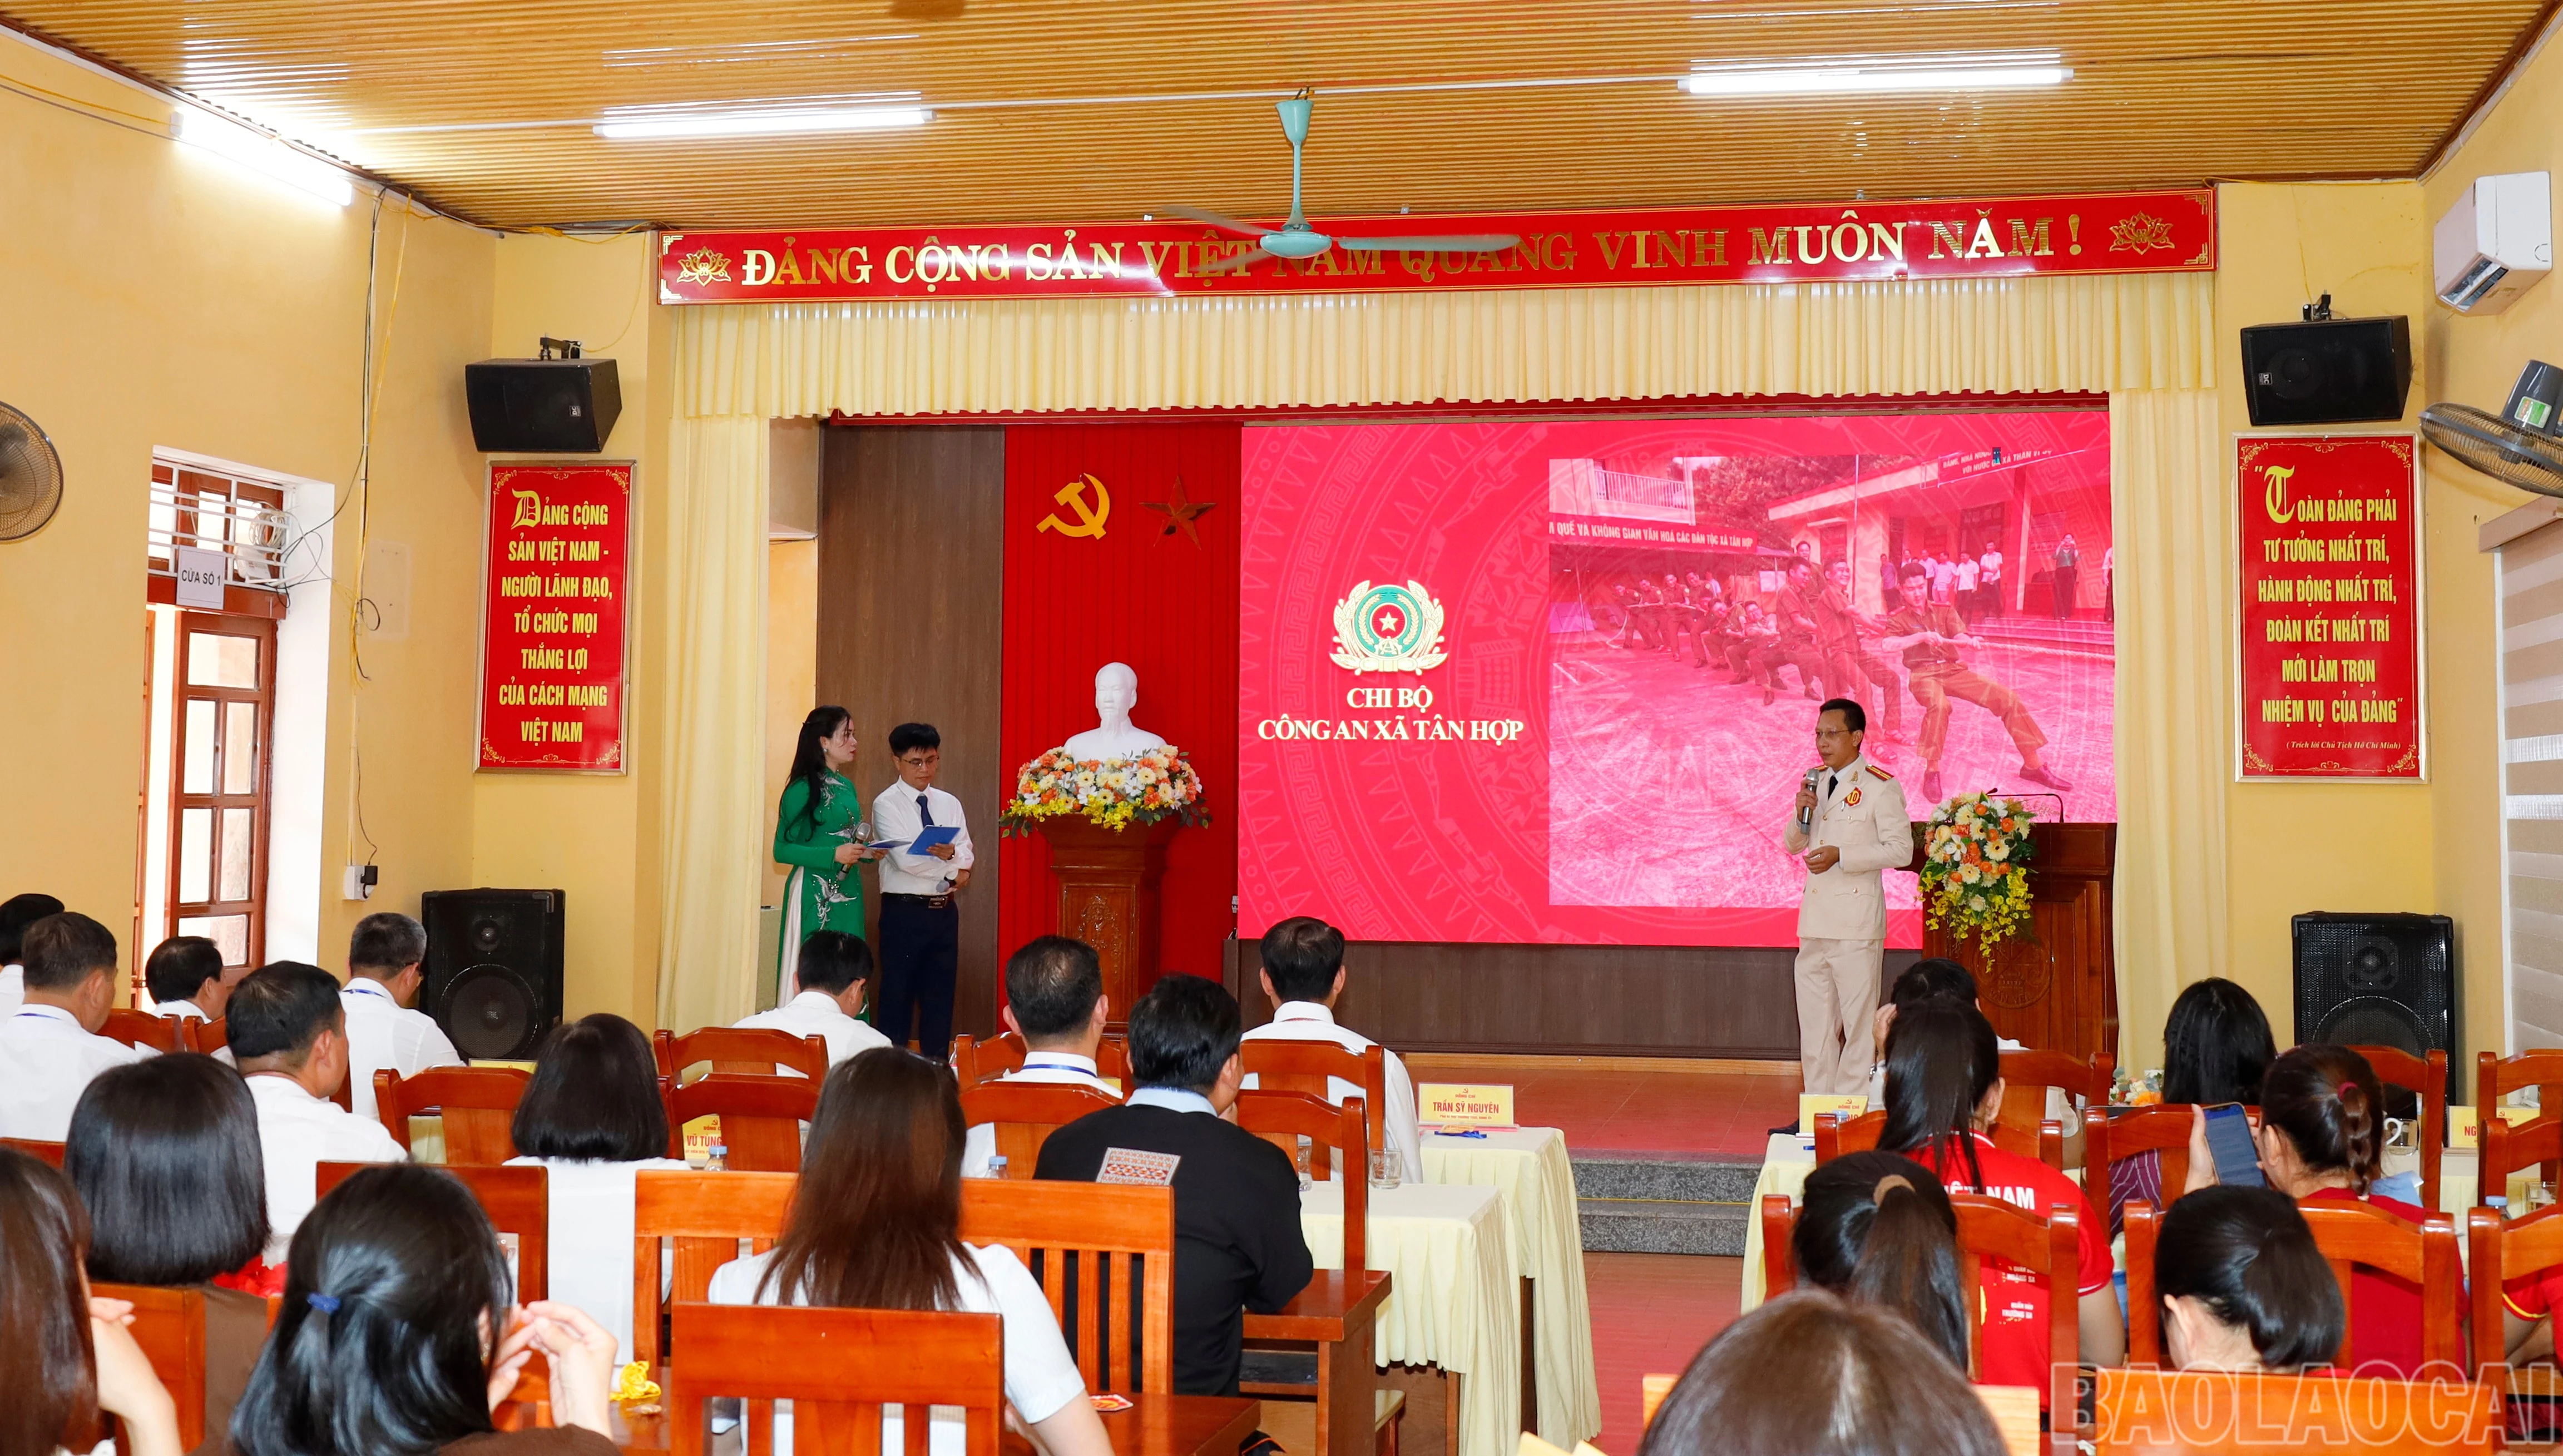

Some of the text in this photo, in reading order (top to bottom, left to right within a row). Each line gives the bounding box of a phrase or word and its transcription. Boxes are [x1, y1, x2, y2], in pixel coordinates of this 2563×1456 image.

[742, 236, 872, 285] ĐẢNG
[885, 235, 1012, 292] CỘNG
[1026, 230, 1124, 282] SẢN
[1138, 229, 1256, 287] VIỆT
[1592, 227, 1730, 269] VINH
[1747, 210, 1907, 265] MUÔN
[1927, 207, 2054, 260] NĂM
[573, 501, 608, 530] CỘNG
[2327, 490, 2363, 522] ĐẢNG
[2367, 489, 2397, 522] PHẢI
[1591, 523, 1621, 538] KHÔNG
[2264, 529, 2389, 564] TƯ TƯỞNG NHẤT TRÍ,
[508, 532, 535, 562] SẢN
[539, 537, 566, 566] VIỆT
[569, 541, 600, 562] NAM
[181, 567, 200, 583] CỬA
[217, 575, 221, 586] 1
[501, 572, 612, 602] NGƯỜI LÃNH ĐẠO,
[2258, 571, 2397, 607] HÀNH ĐỘNG NHẤT TRÍ,
[514, 605, 597, 638] TỔ CHỨC MỌI
[2266, 611, 2390, 643] ĐOÀN KẾT NHẤT TRÍ
[521, 642, 588, 675] THẮNG LỢI
[2282, 653, 2376, 687] MỚI LÀM TRỌN
[499, 675, 607, 711] CỦA CÁCH MẠNG
[1347, 685, 1433, 714] CHI BỘ
[2262, 695, 2304, 727] NHIỆM
[2307, 699, 2324, 727] VỤ
[2332, 691, 2358, 723] CỦA
[521, 717, 583, 746] VIỆT NAM
[1258, 714, 1524, 746] CÔNG AN XÃ TÂN HỢP
[2337, 741, 2352, 750] Tịch
[1848, 791, 1858, 802] 10
[1468, 1101, 1499, 1113] NGUYÊN
[687, 1133, 697, 1146] VŨ
